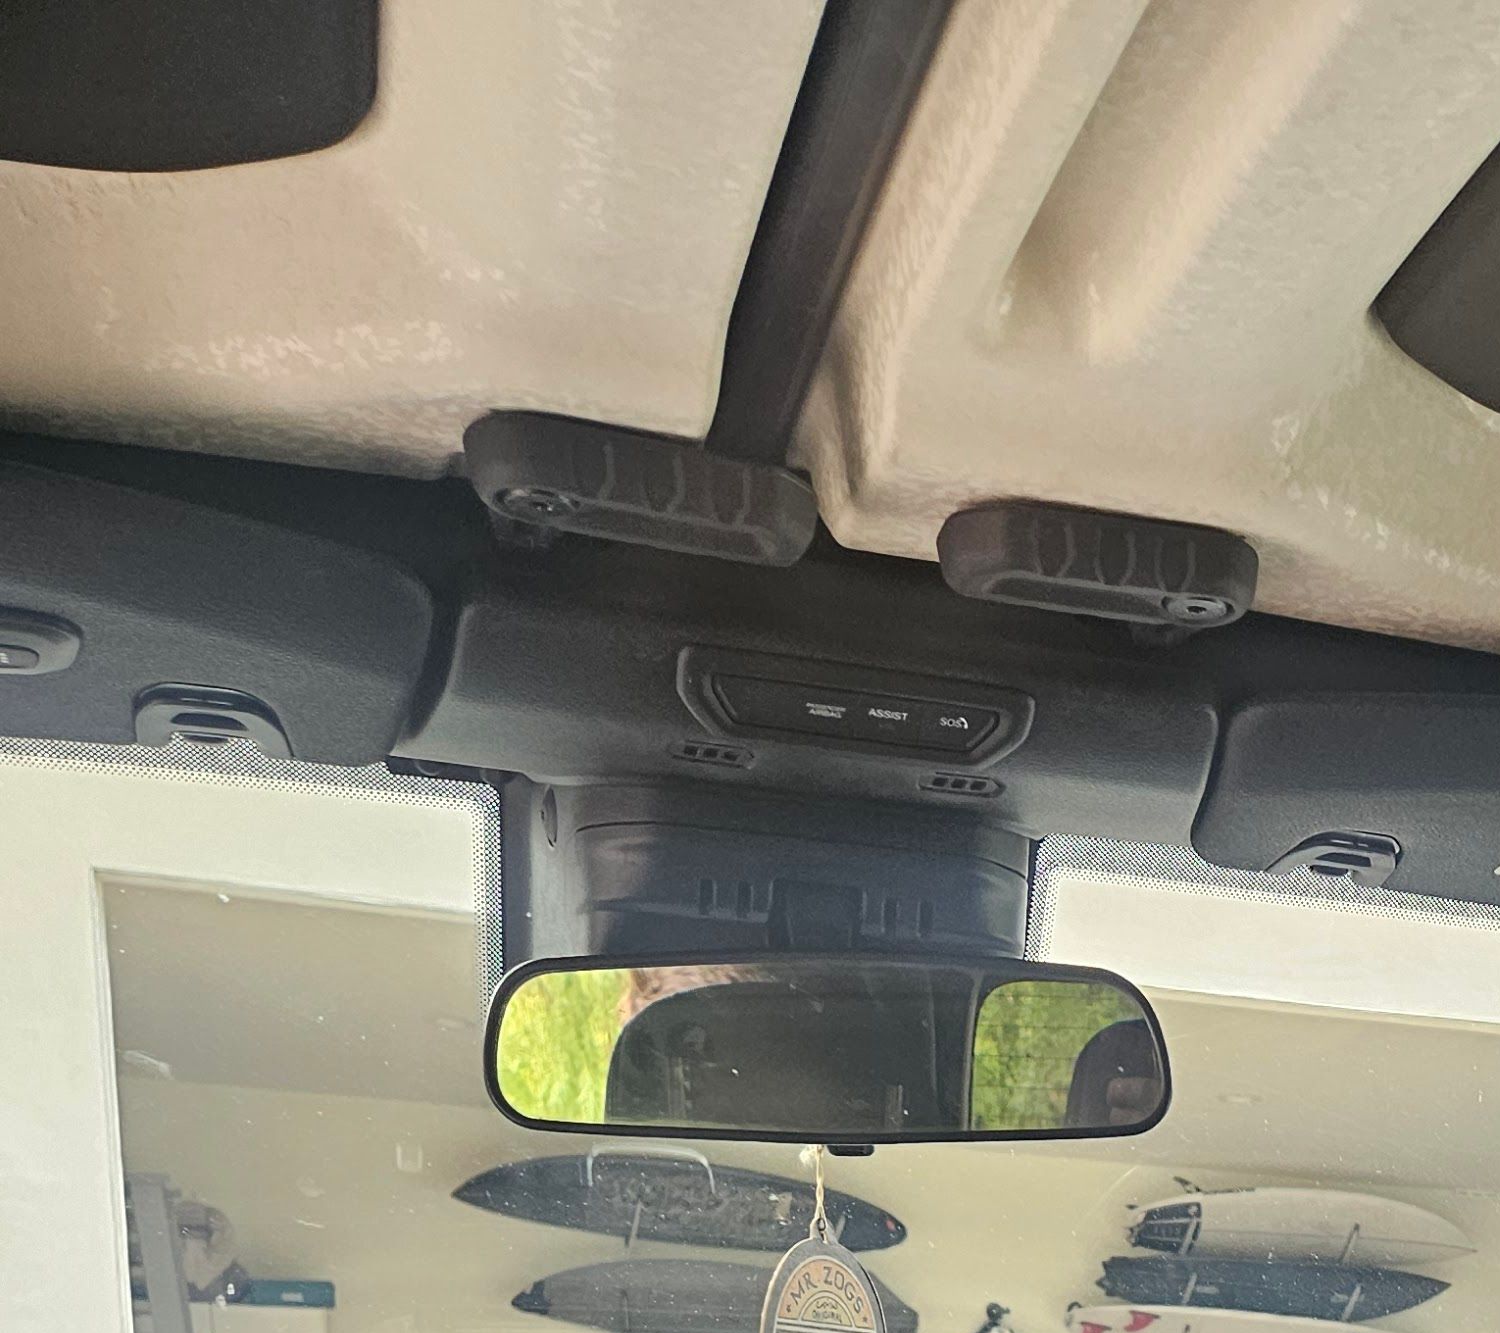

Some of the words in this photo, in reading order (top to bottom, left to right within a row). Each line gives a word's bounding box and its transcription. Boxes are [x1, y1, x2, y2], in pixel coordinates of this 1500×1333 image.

[868, 708, 908, 721] ASSIST
[939, 716, 962, 728] SOS
[823, 1266, 864, 1314] ZOGS
